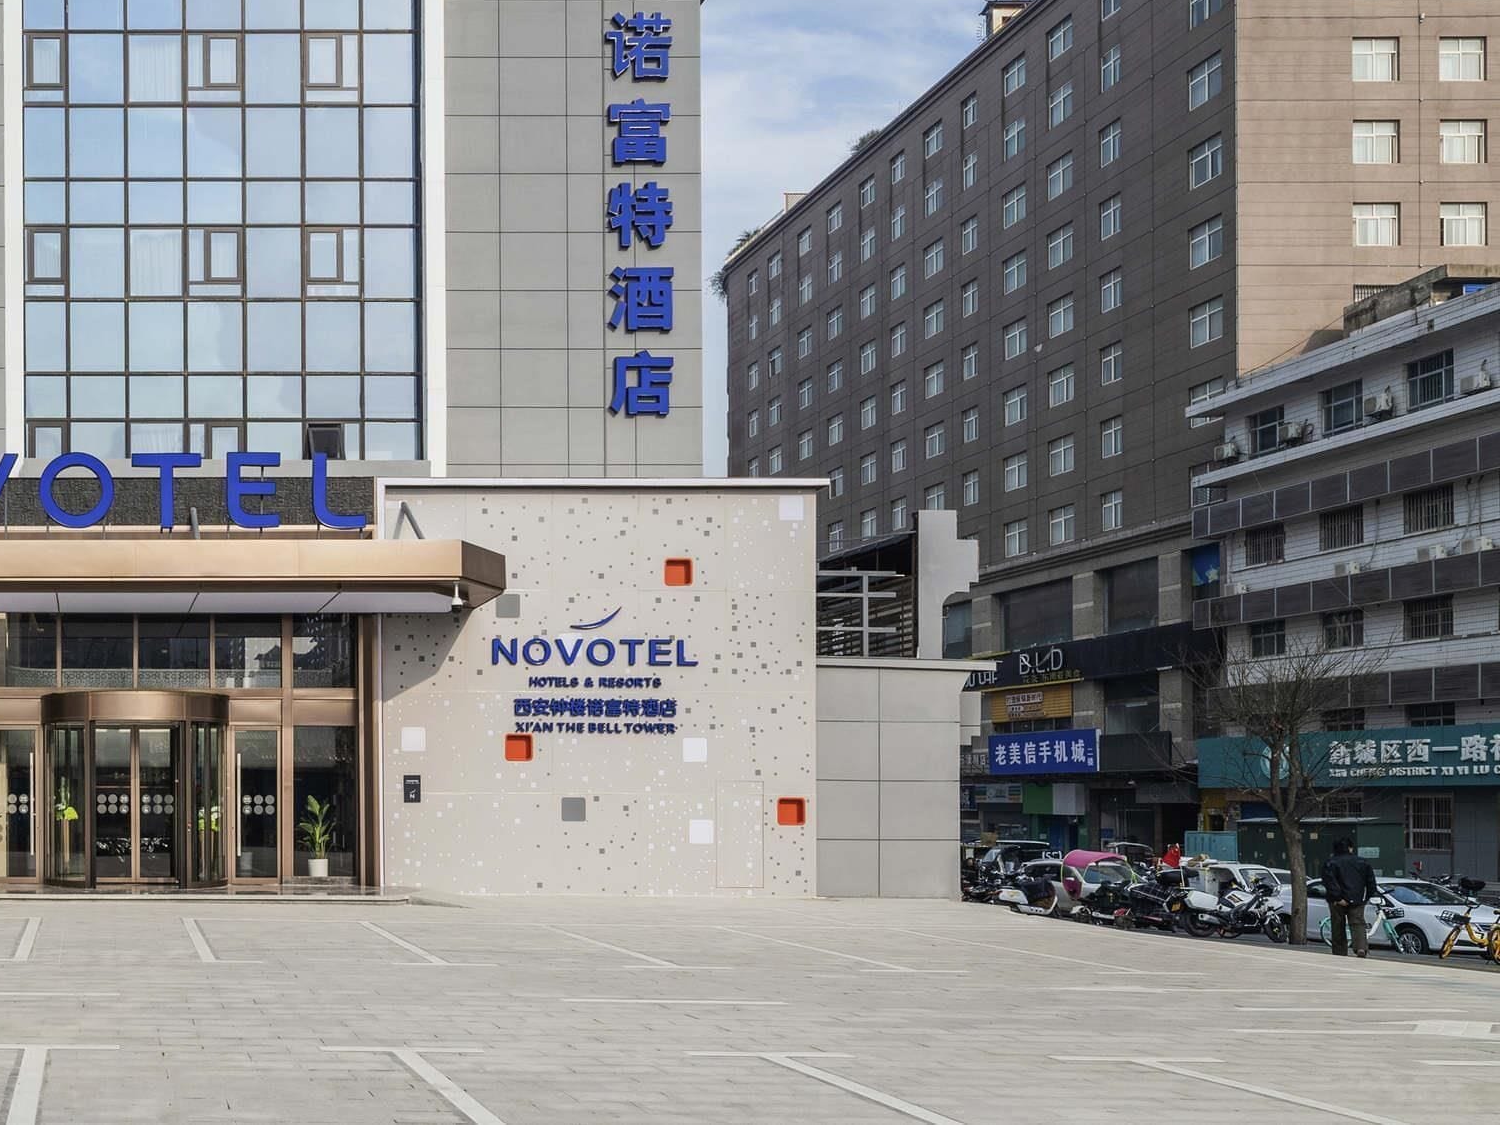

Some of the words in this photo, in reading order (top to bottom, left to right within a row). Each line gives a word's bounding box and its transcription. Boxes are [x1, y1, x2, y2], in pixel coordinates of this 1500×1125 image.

[491, 637, 699, 667] NOVOTEL
[528, 676, 579, 688] HOTELS
[584, 676, 594, 688] &
[598, 676, 662, 689] RESORTS
[513, 698, 678, 717] 西安钟楼诺富特酒店
[557, 722, 584, 734] THE
[588, 722, 622, 734] BELL
[625, 722, 676, 735] TOWER
[995, 739, 1087, 766] 老美信手机城
[1389, 766, 1438, 777] DISTRICT
[1473, 765, 1490, 775] LU
